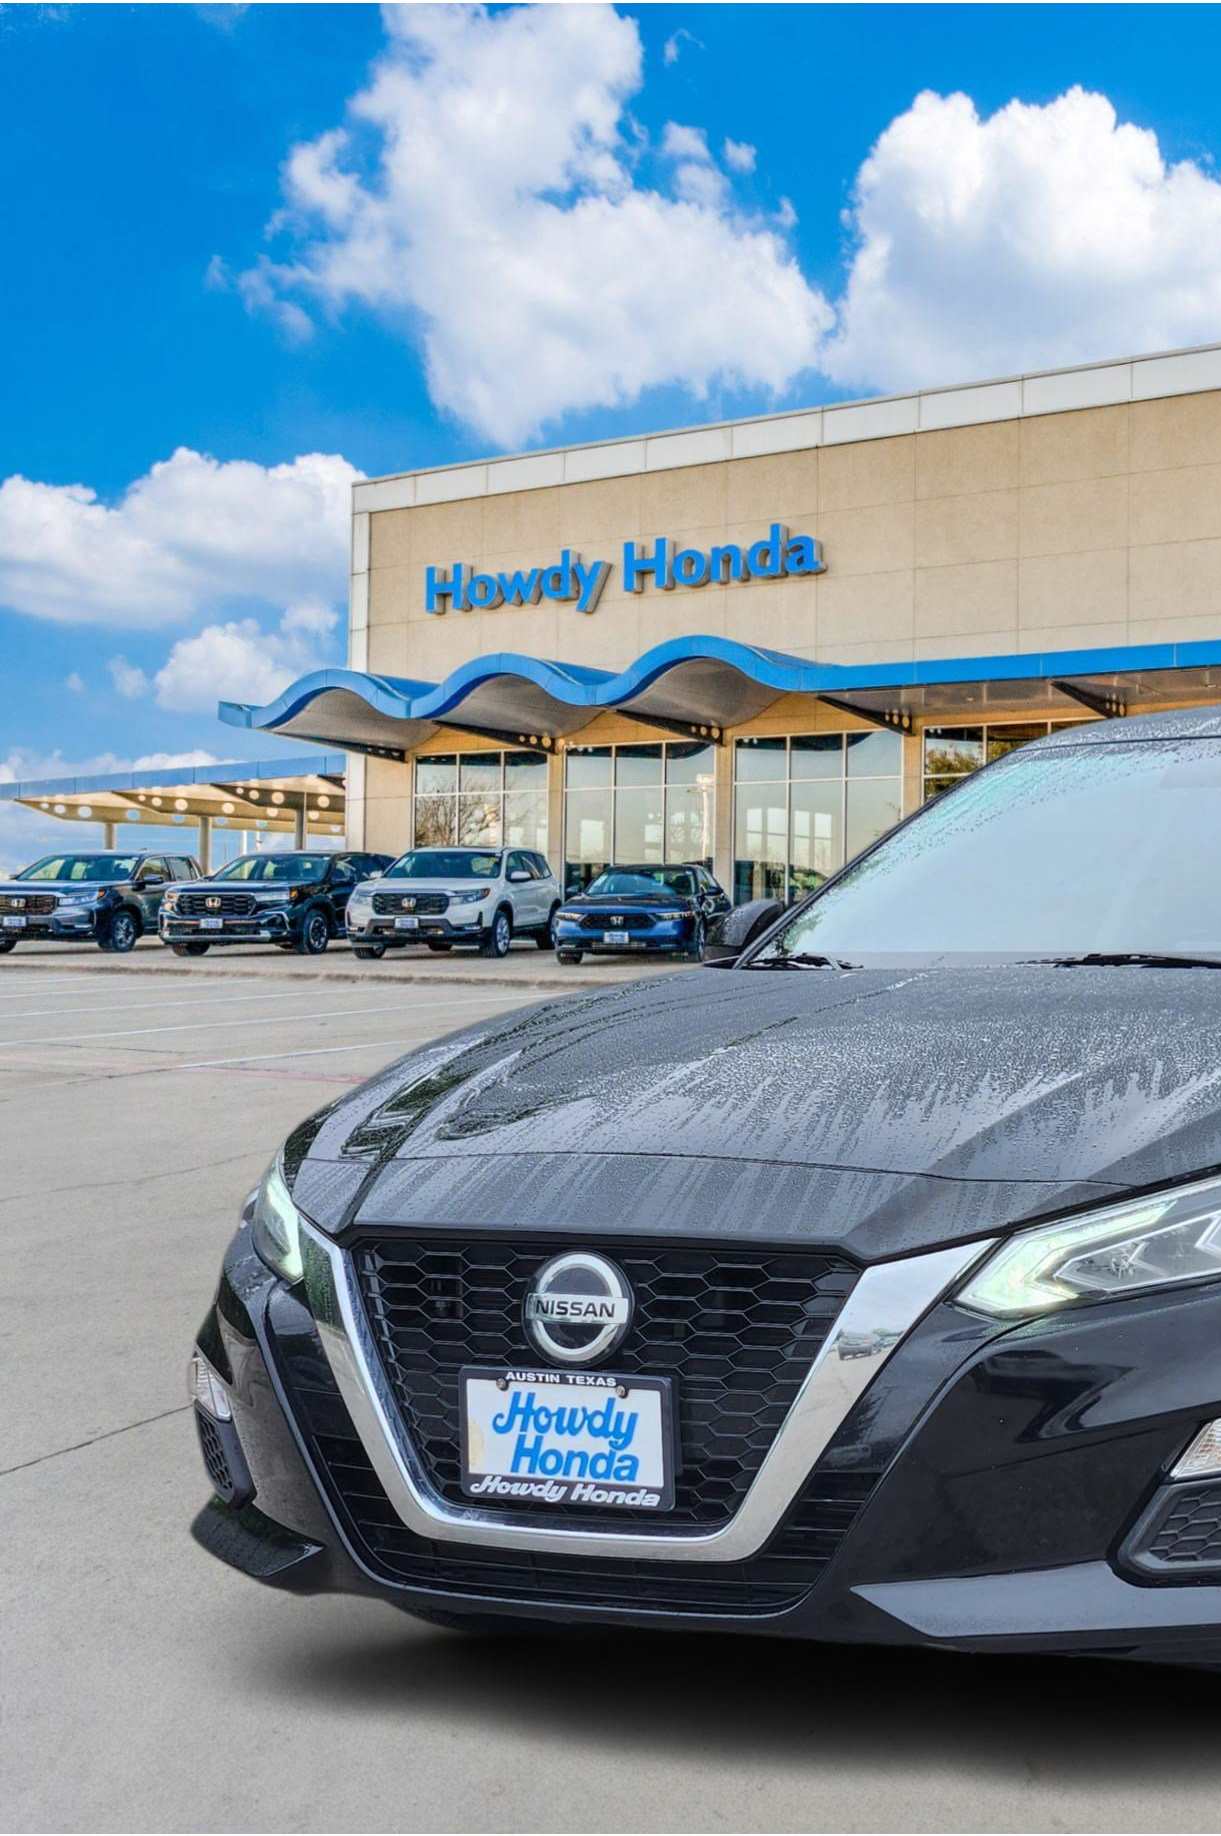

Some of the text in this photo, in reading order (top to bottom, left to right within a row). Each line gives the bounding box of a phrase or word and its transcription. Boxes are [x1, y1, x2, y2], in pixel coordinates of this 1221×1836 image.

[425, 523, 827, 615] Howdy Honda
[535, 1299, 616, 1318] NISSAN
[506, 1371, 617, 1387] AUSTIN TEXAS
[492, 1391, 639, 1450] Howdy
[510, 1434, 640, 1482] Honda
[470, 1475, 661, 1507] Howdy Honda
